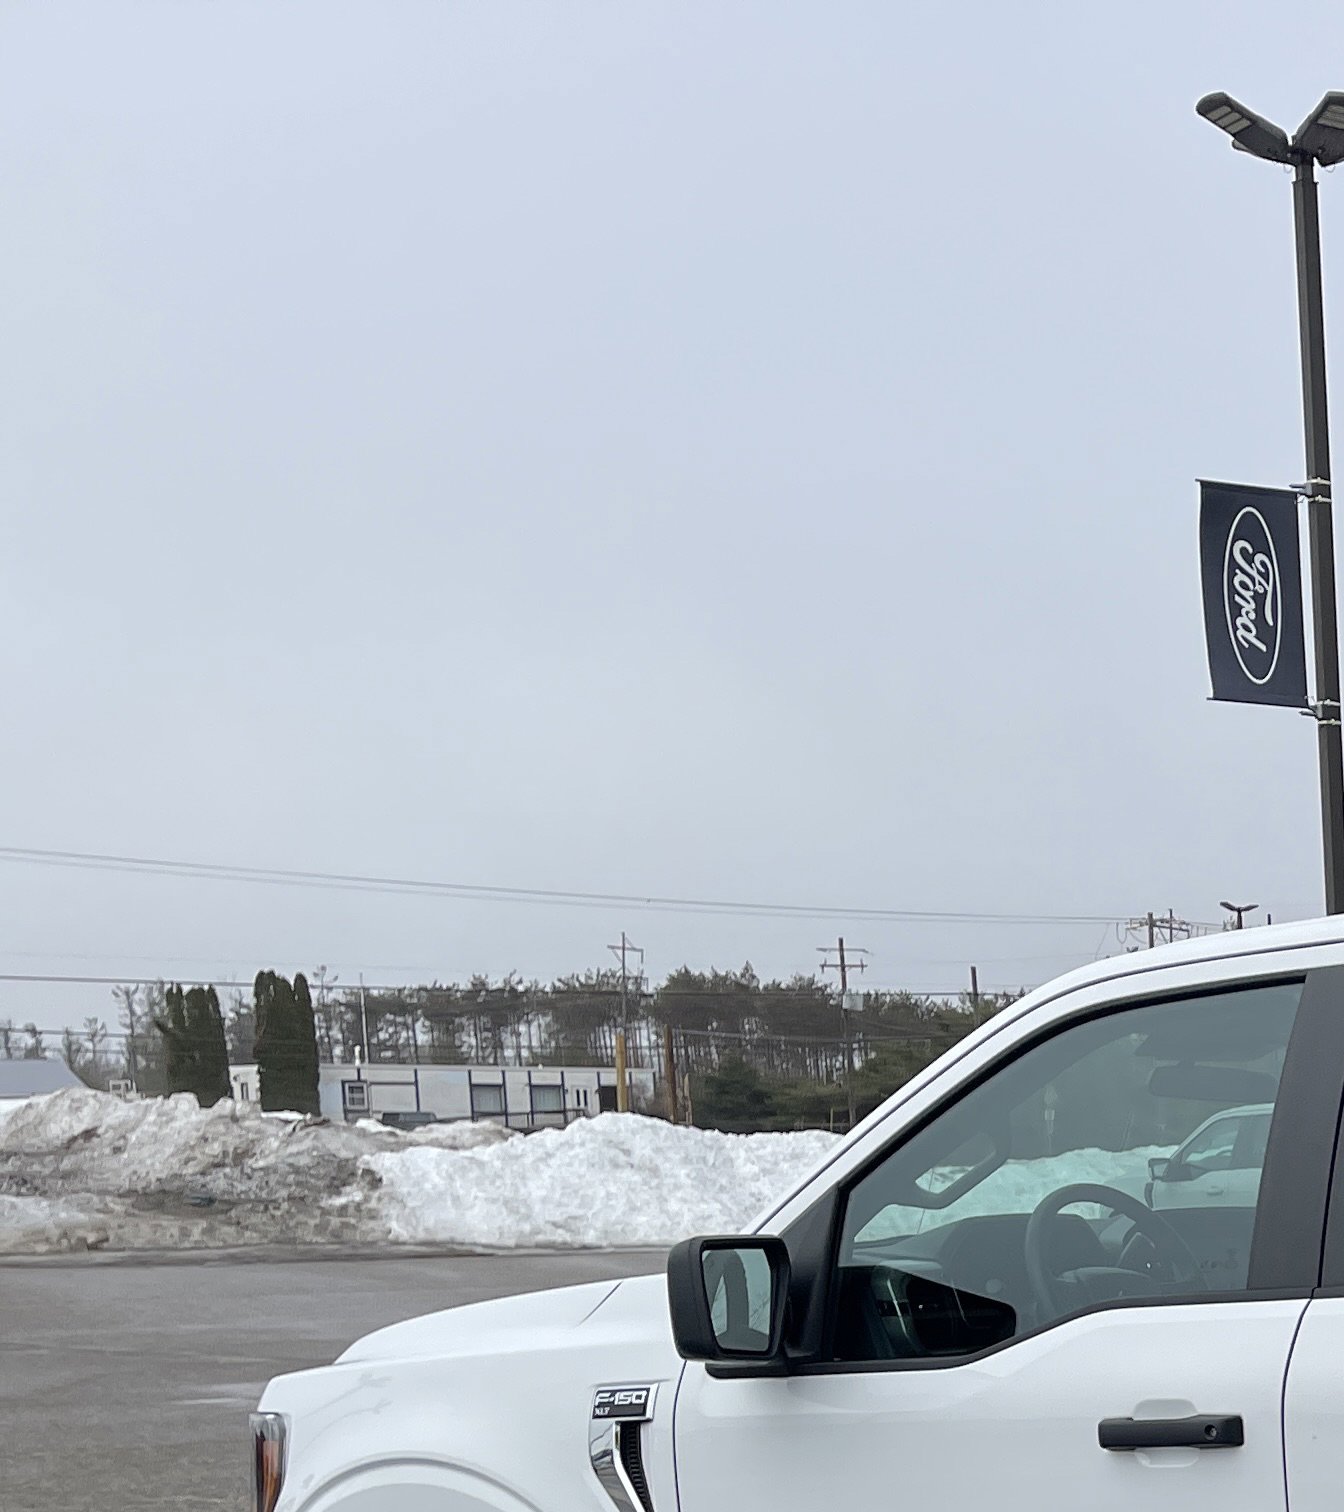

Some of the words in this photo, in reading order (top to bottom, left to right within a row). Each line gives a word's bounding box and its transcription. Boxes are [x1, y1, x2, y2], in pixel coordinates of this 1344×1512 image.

[1233, 539, 1274, 653] Ford
[595, 1391, 647, 1406] F-150
[594, 1407, 610, 1416] XLT
